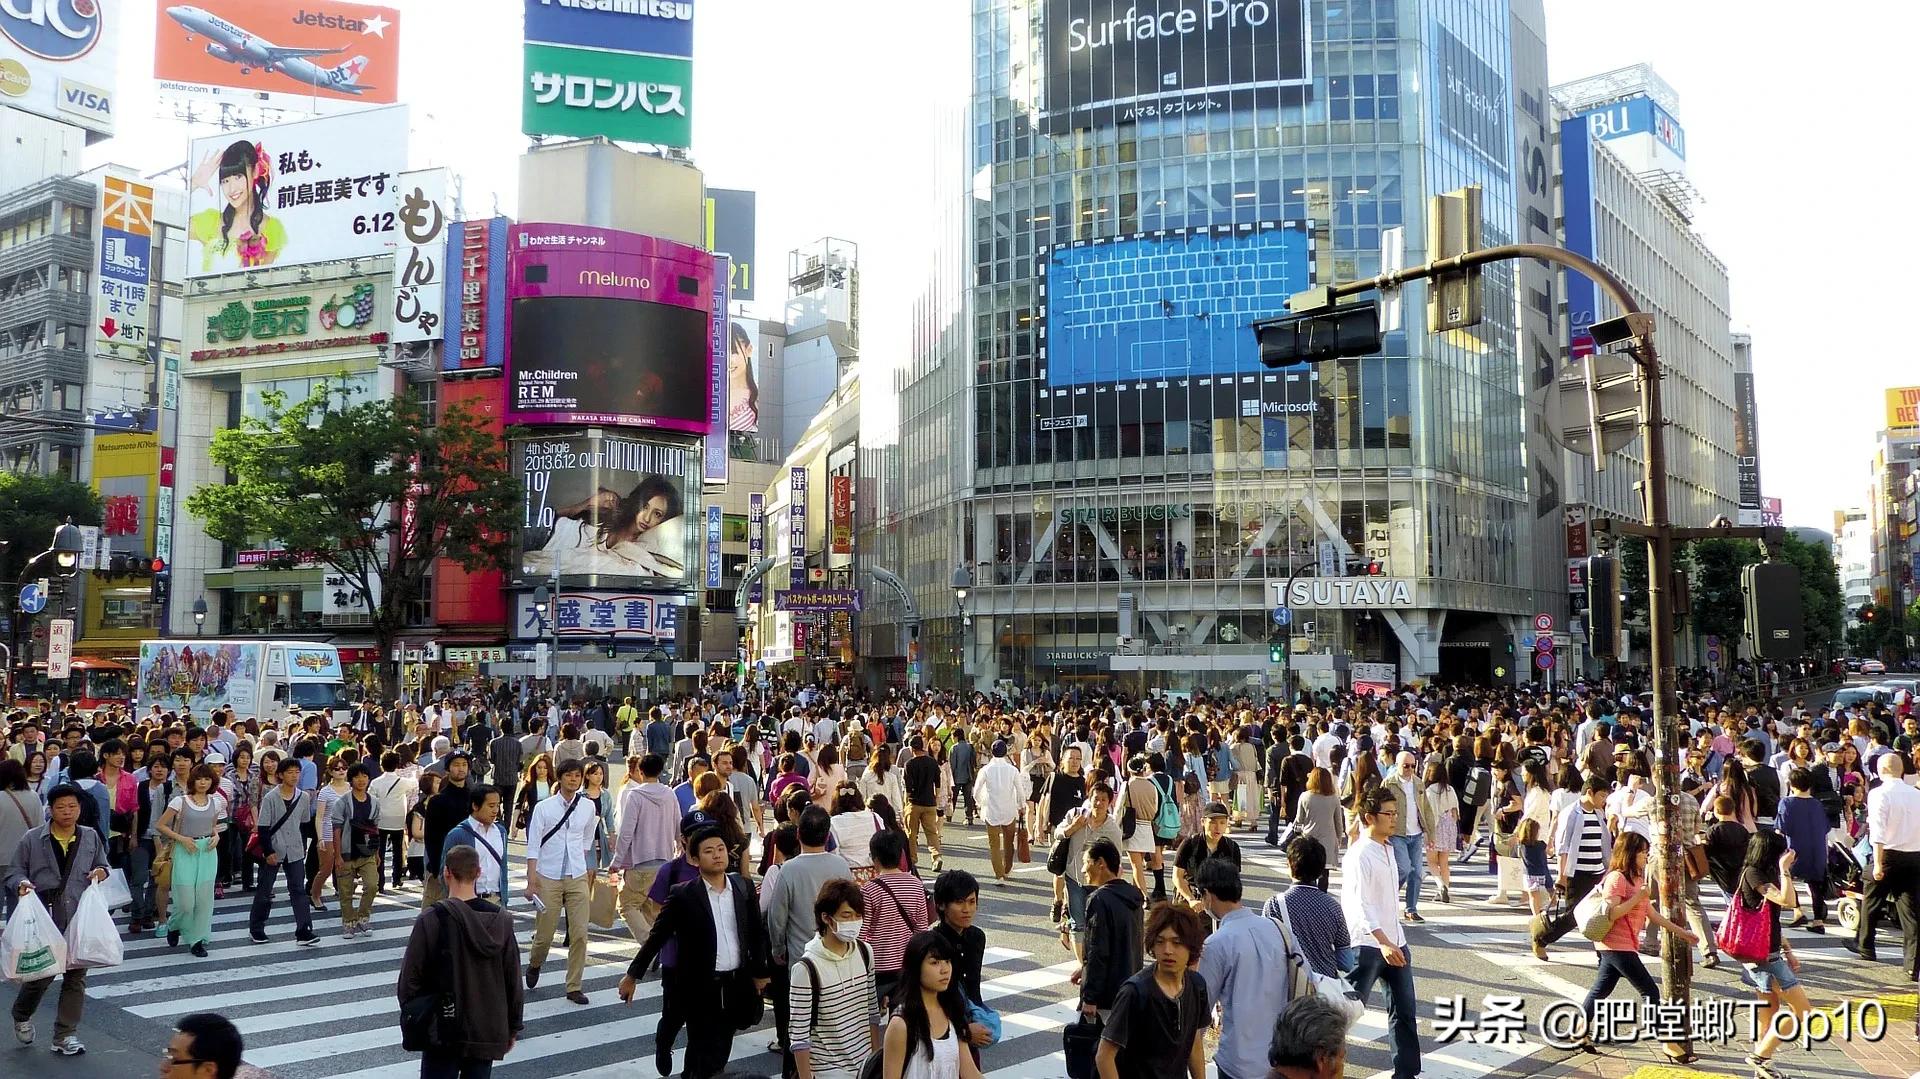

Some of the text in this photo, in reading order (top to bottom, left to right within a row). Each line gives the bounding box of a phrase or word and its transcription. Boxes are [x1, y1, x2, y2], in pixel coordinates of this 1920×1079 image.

[208, 16, 246, 40] Jetstar
[292, 9, 368, 33] Jetstar
[1068, 0, 1269, 51] Surface Pro
[160, 81, 208, 94] jetstar.com
[531, 71, 685, 117] サロンパス
[66, 89, 110, 114] VISA
[278, 151, 322, 175] 私も、
[277, 171, 400, 210] 前島亜美です。
[353, 211, 395, 235] 6.12
[529, 235, 606, 247] わかさ生活 チャンネル
[395, 187, 443, 336] もんじゃ
[101, 279, 146, 302] 夜11時
[460, 225, 482, 360] 三千里薬品
[109, 300, 137, 317] まで
[121, 322, 145, 341] 地下
[519, 370, 578, 380] Mr.Children
[1263, 400, 1318, 413] Microsoft
[629, 417, 656, 425] CHANNEL
[525, 441, 570, 454] 4th Single
[525, 452, 606, 471] 2013.6.12 OUT
[792, 471, 804, 549] 洋服の青山
[1060, 503, 1194, 524] STARBUCKS
[1271, 581, 1411, 605] TSUTAYA
[525, 600, 676, 630] 大盛堂書店
[50, 625, 63, 673] 道玄坂
[1046, 651, 1098, 660] STARBUCKS
